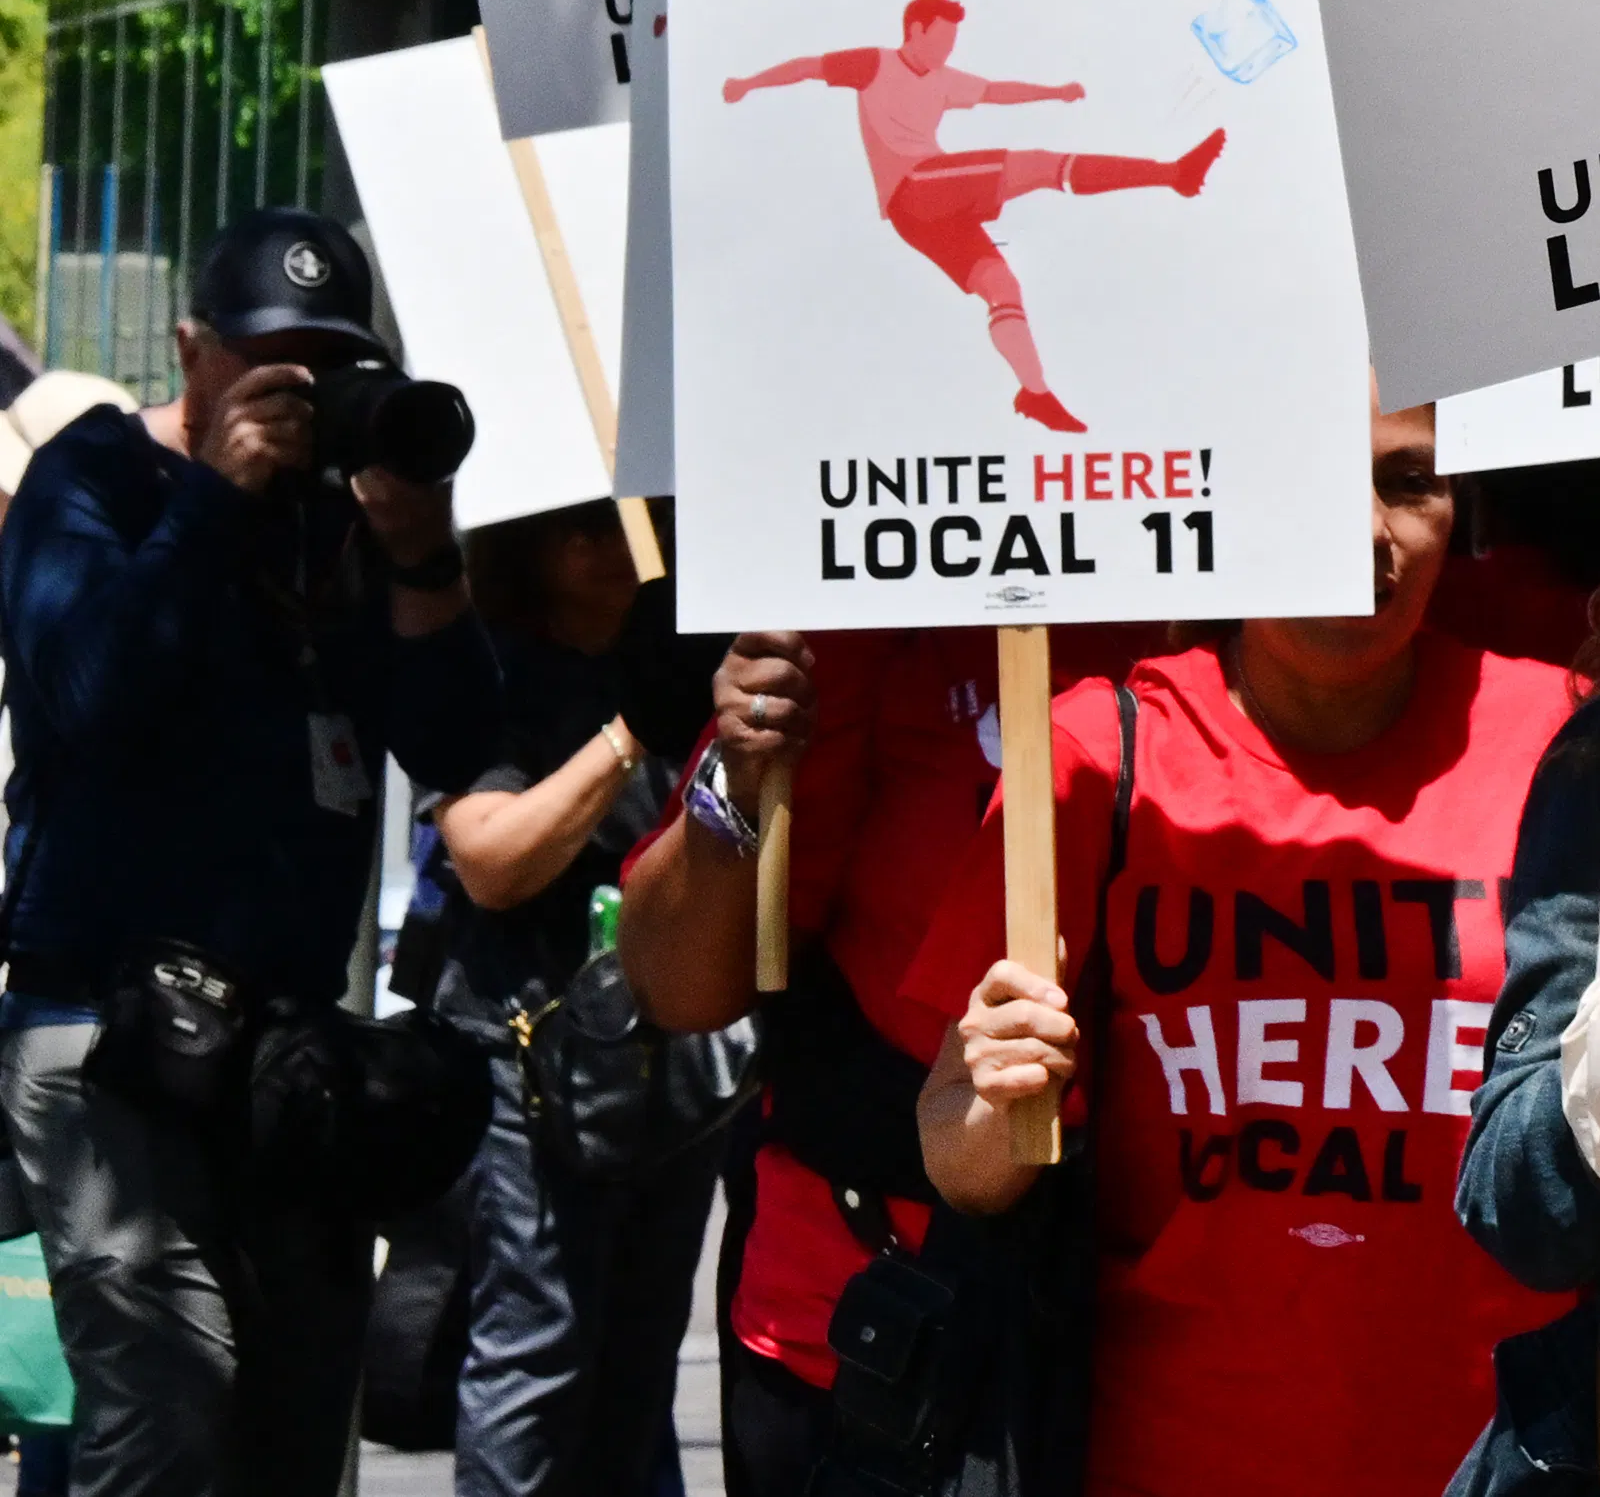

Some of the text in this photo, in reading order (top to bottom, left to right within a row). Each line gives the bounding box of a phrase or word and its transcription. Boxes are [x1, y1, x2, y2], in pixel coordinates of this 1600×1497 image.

[821, 450, 1212, 508] UNITE HERE!
[822, 512, 1213, 579] LOCAL 11
[1134, 878, 1508, 995] UNIT
[1138, 999, 1496, 1116] HERE
